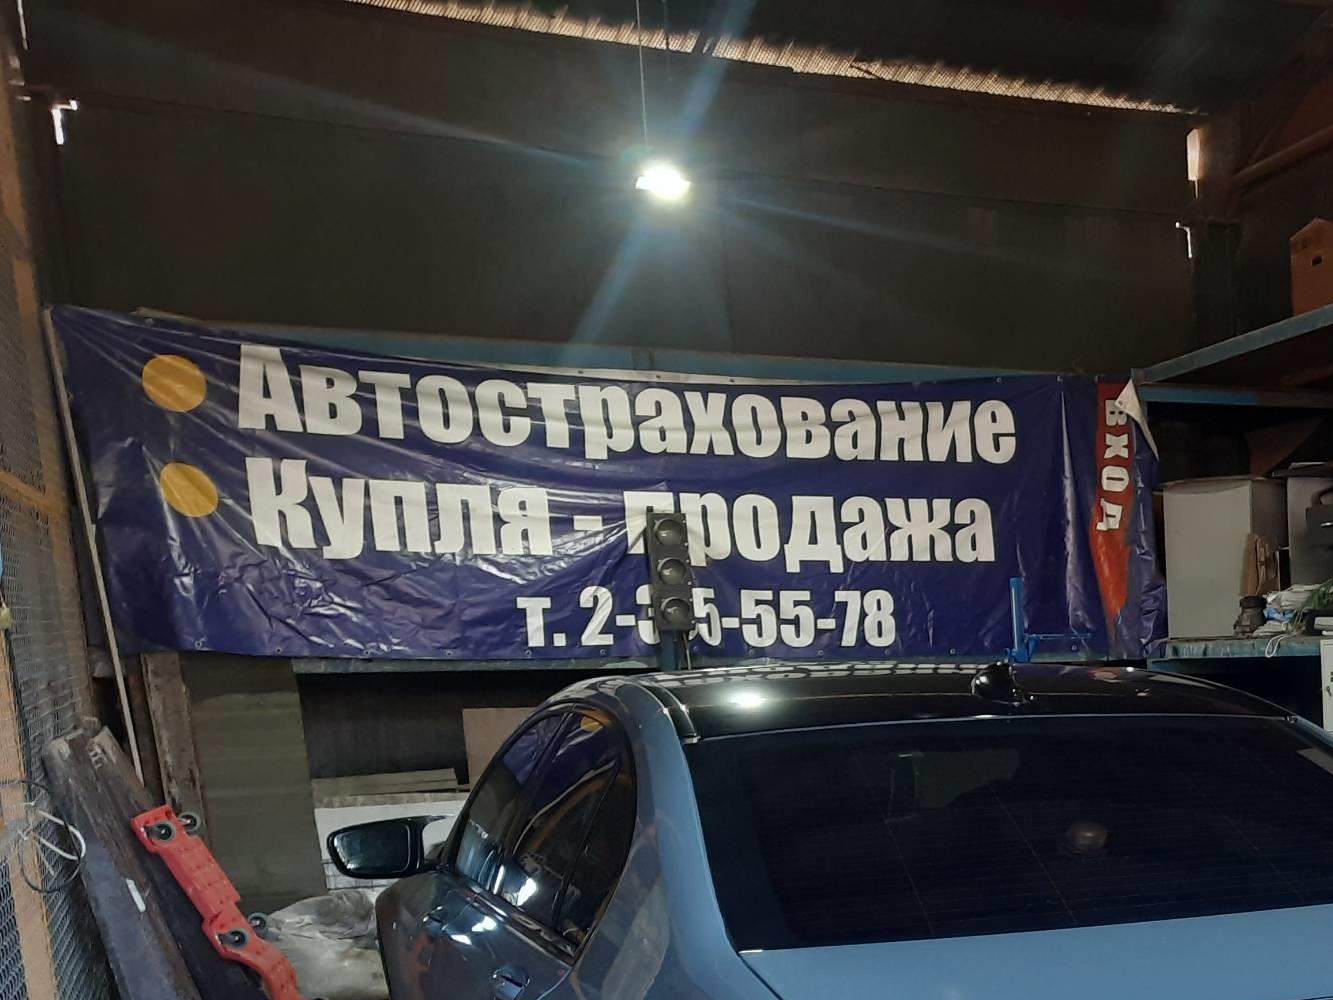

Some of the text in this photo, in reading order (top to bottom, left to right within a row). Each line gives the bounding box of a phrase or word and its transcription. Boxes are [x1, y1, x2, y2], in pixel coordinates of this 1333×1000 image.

[238, 343, 1017, 465] Автострахование
[1096, 399, 1130, 530] ВХОД
[245, 456, 553, 559] Купля
